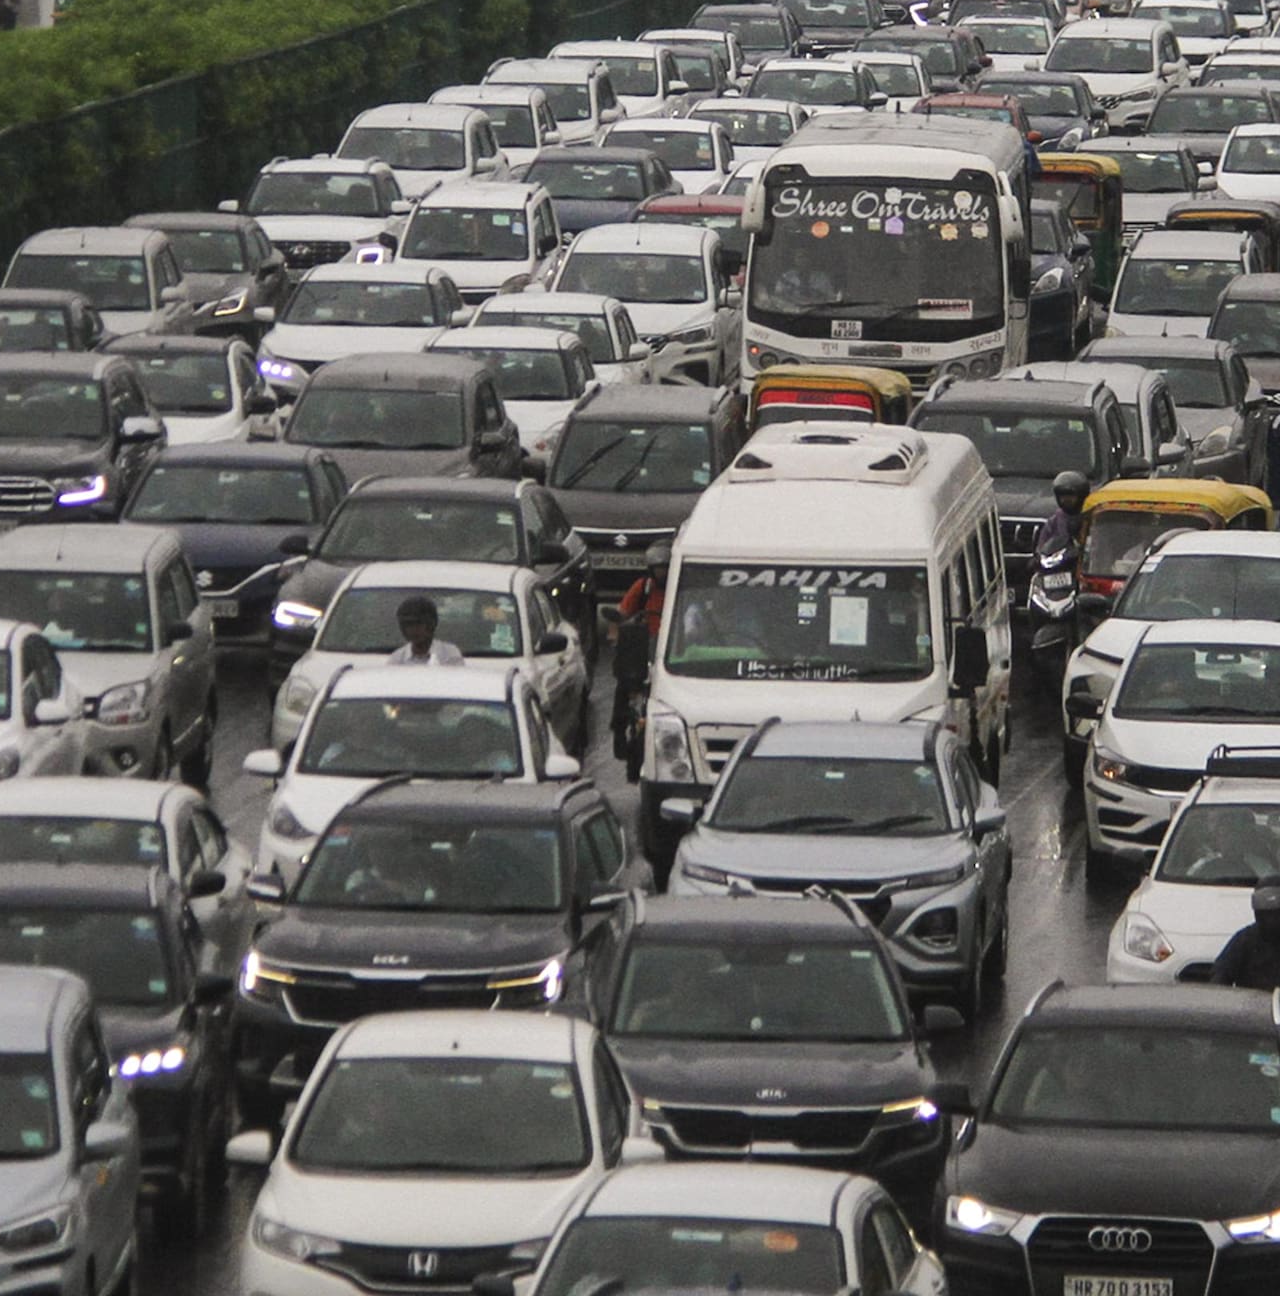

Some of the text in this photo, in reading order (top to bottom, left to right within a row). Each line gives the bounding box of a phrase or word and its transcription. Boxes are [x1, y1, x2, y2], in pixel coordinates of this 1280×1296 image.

[771, 186, 991, 222] Shree Om Travels
[718, 569, 887, 589] DAHIYA
[737, 660, 860, 681] Uber Shuttle
[1074, 1280, 1093, 1296] HR
